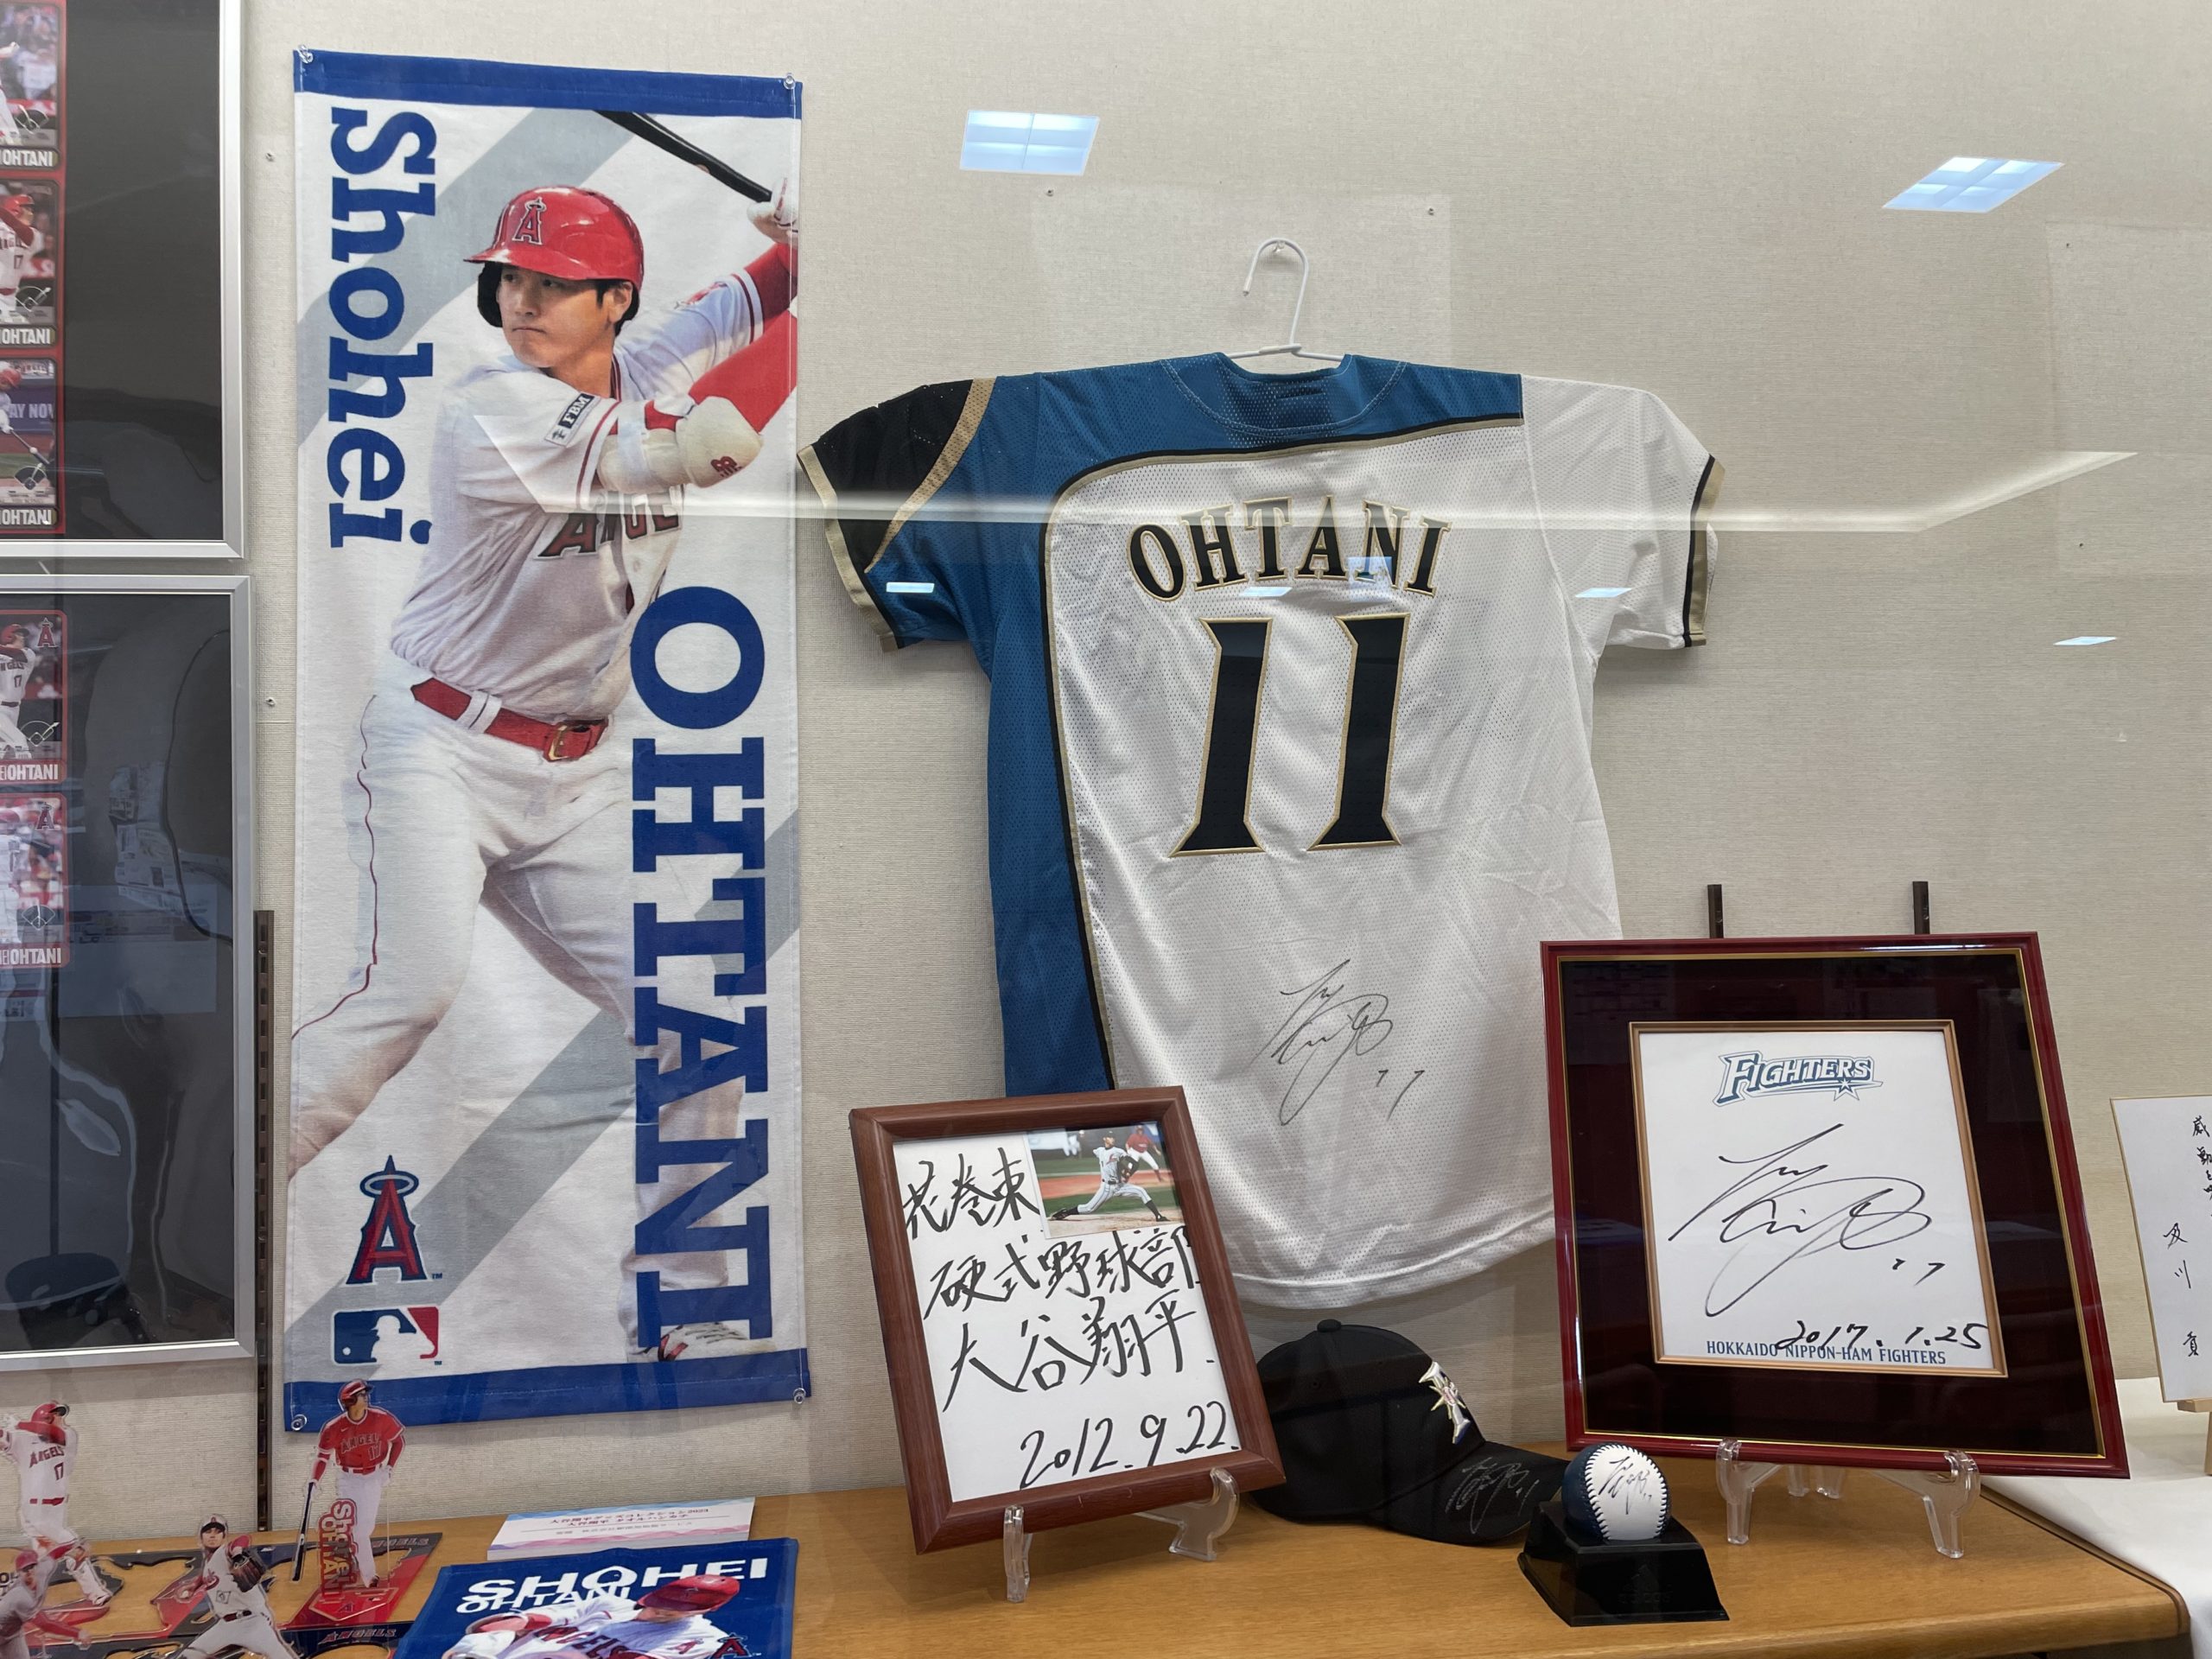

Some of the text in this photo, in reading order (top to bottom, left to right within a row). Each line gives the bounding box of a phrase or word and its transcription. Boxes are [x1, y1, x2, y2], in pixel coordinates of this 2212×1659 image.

[3, 150, 53, 167] OHTANI
[2, 328, 51, 345] OHTANI
[327, 107, 437, 549] Shohei
[2, 509, 52, 525] OHTANI
[1126, 494, 1452, 602] OHTANI
[1169, 613, 1411, 858] 11
[7, 764, 58, 780] OHTANI
[10, 948, 61, 965] OHTANI
[631, 587, 772, 1347] OHTANI
[1713, 1051, 1875, 1107] FIGHTERS
[1707, 1340, 1947, 1364] HOKKAIDO NIPPON-HAM FIGHTERS
[462, 1558, 768, 1605] SHOHEI
